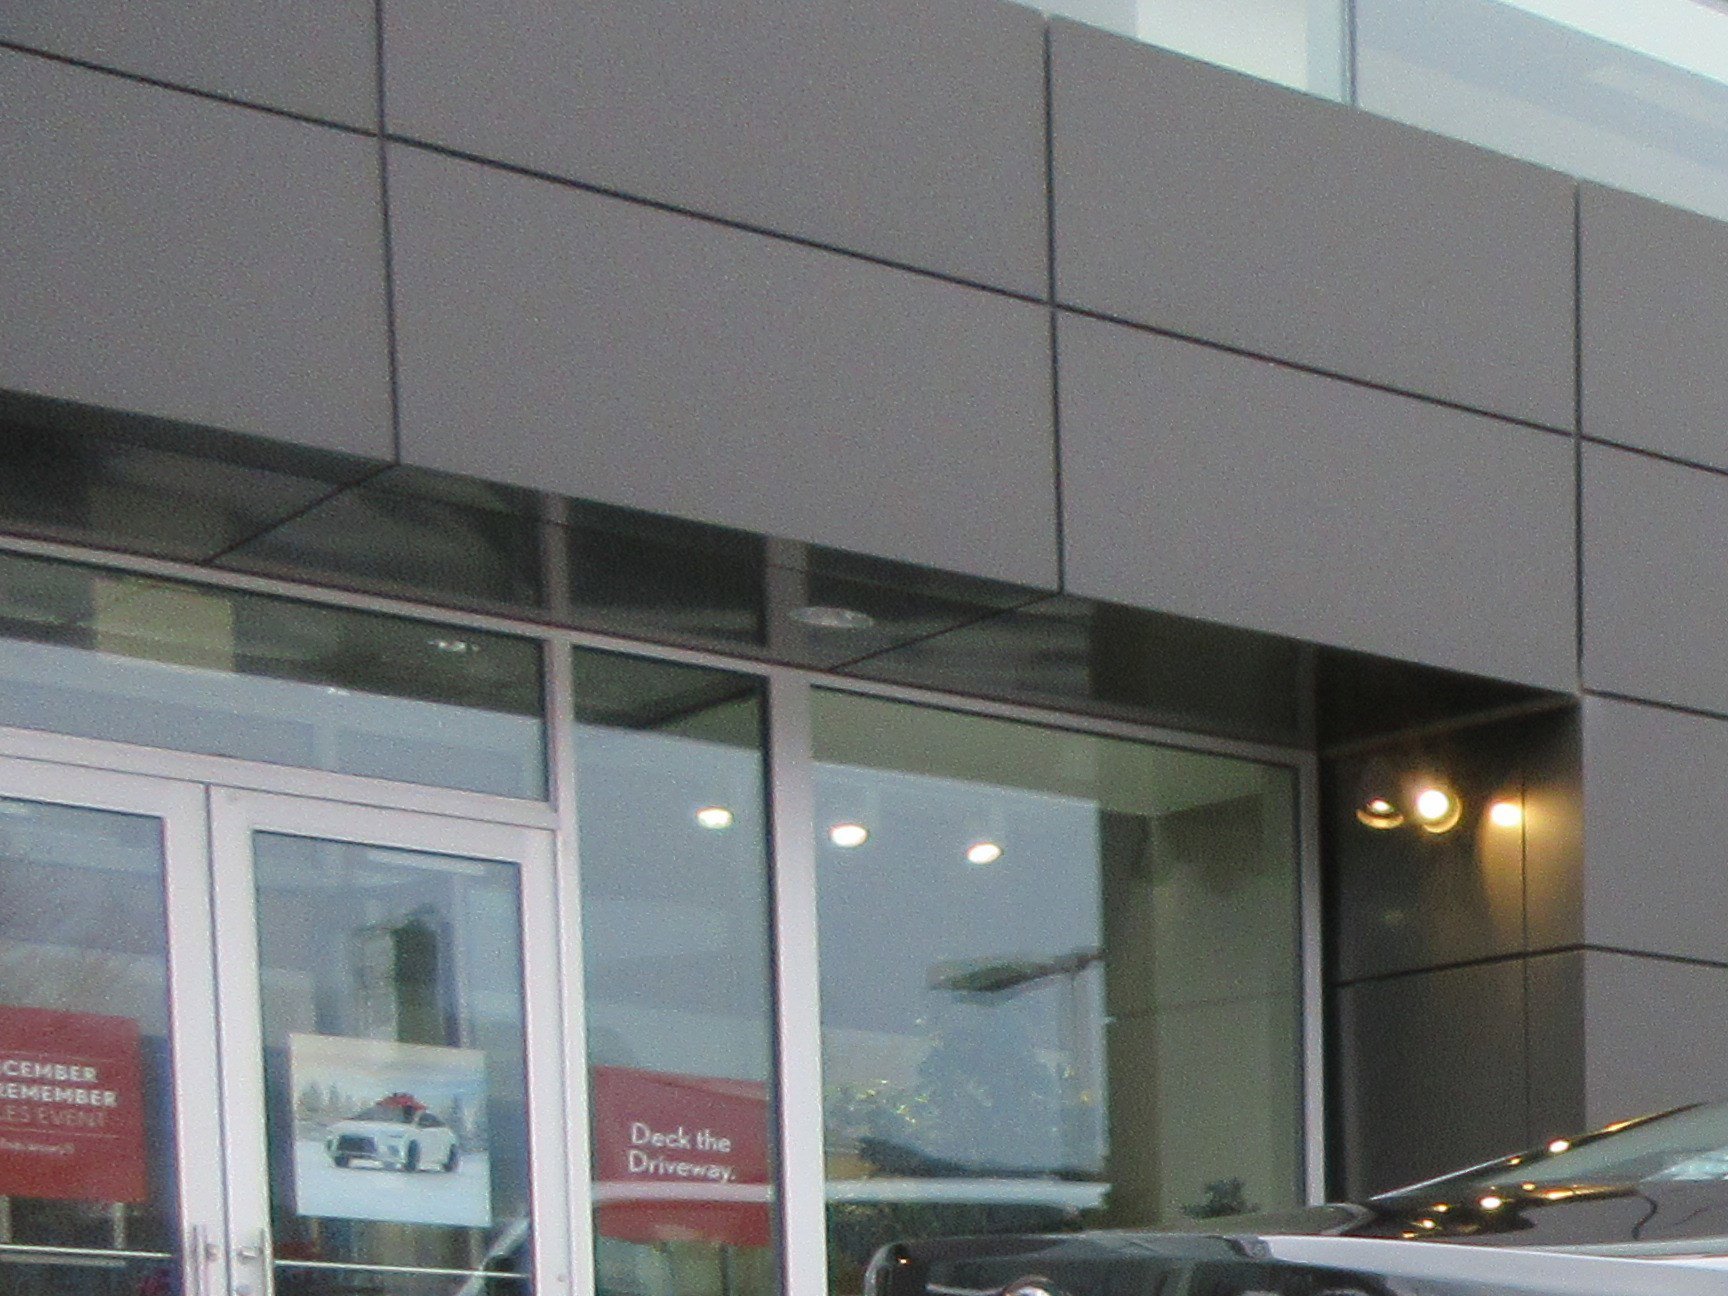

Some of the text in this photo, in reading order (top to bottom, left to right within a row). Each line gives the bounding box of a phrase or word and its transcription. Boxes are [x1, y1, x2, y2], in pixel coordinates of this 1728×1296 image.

[631, 1121, 732, 1153] Deck the
[628, 1149, 736, 1184] Driveway.
